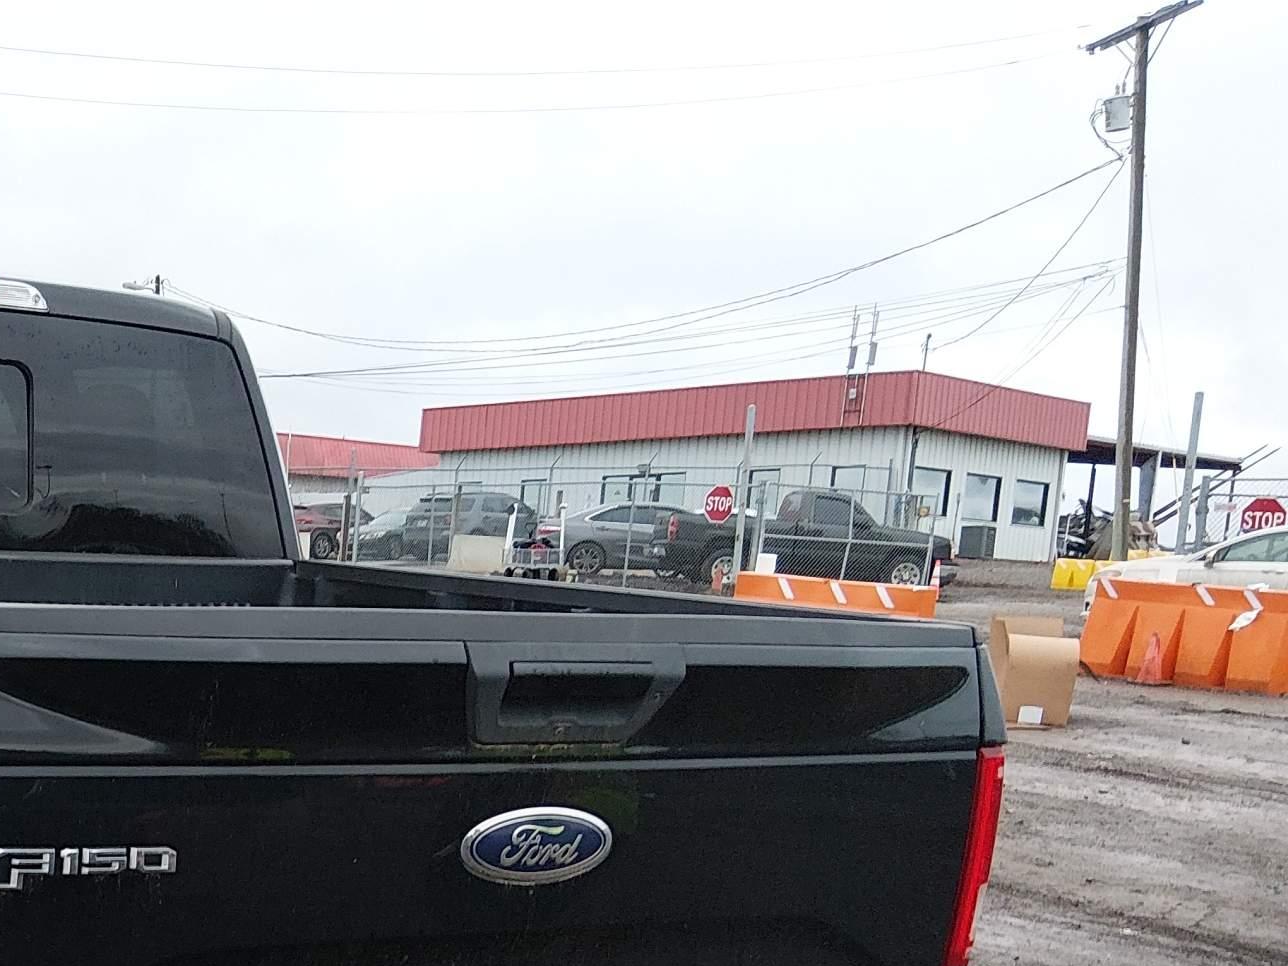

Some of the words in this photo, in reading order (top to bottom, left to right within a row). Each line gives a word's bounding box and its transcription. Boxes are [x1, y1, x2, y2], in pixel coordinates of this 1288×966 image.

[706, 496, 732, 512] STOP
[1243, 511, 1285, 530] STOP
[500, 824, 583, 867] Ford
